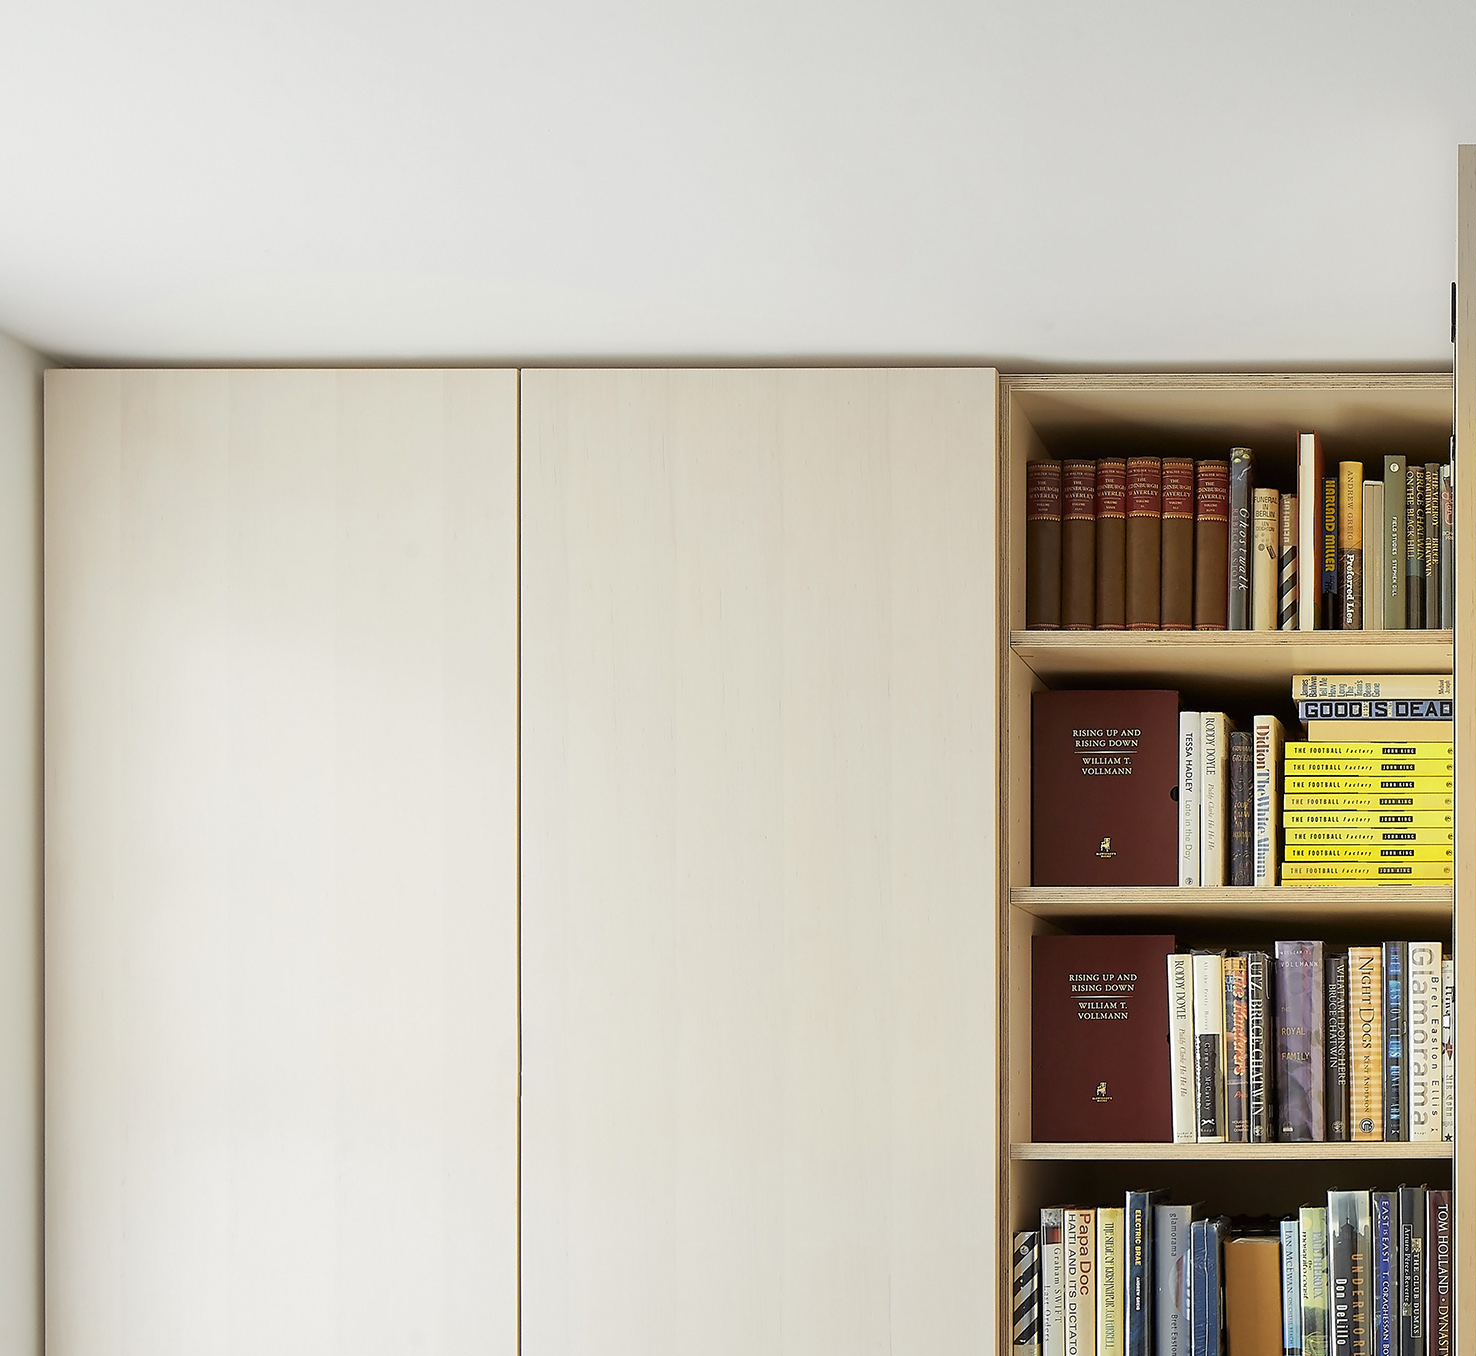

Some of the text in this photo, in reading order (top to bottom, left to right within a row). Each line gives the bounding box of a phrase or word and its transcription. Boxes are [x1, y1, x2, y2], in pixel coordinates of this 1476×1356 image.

[1325, 480, 1336, 572] HARLAND MILLER
[1238, 508, 1250, 591] Ghostwalk
[1345, 554, 1355, 624] Preferred Lies
[1304, 701, 1452, 717] GOOD IS DEAD
[1072, 729, 1142, 737] RISING UP AND
[1075, 740, 1138, 748] RISING DOWN
[1206, 718, 1216, 775] RODDY DOYLE
[1256, 725, 1270, 770] Didion
[1081, 768, 1133, 776] VOLLMANN
[1082, 757, 1132, 765] WILLIAM T.
[1185, 732, 1193, 792] TESSA HADLEY
[1068, 973, 1138, 981] RISING UP AND
[1071, 984, 1134, 992] RISING DOWN
[1078, 1002, 1128, 1010] WILLIAM T.
[1078, 1012, 1129, 1020] VOLLMANN
[1358, 956, 1374, 1049] NIGHT DOGS
[1250, 961, 1263, 1116] UTZ BRUCE CHATWIN
[1412, 948, 1434, 1126] Glamorama
[1431, 976, 1440, 1116] Bret Easton Ellis
[1069, 1214, 1078, 1245] HAITI
[1438, 1203, 1449, 1294] TOM HOLLAND
[1069, 1250, 1078, 1276] AND
[1078, 1214, 1091, 1295] Papa Doc
[1069, 1280, 1078, 1298] ITS
[1336, 1278, 1348, 1346] Don DeLillo
